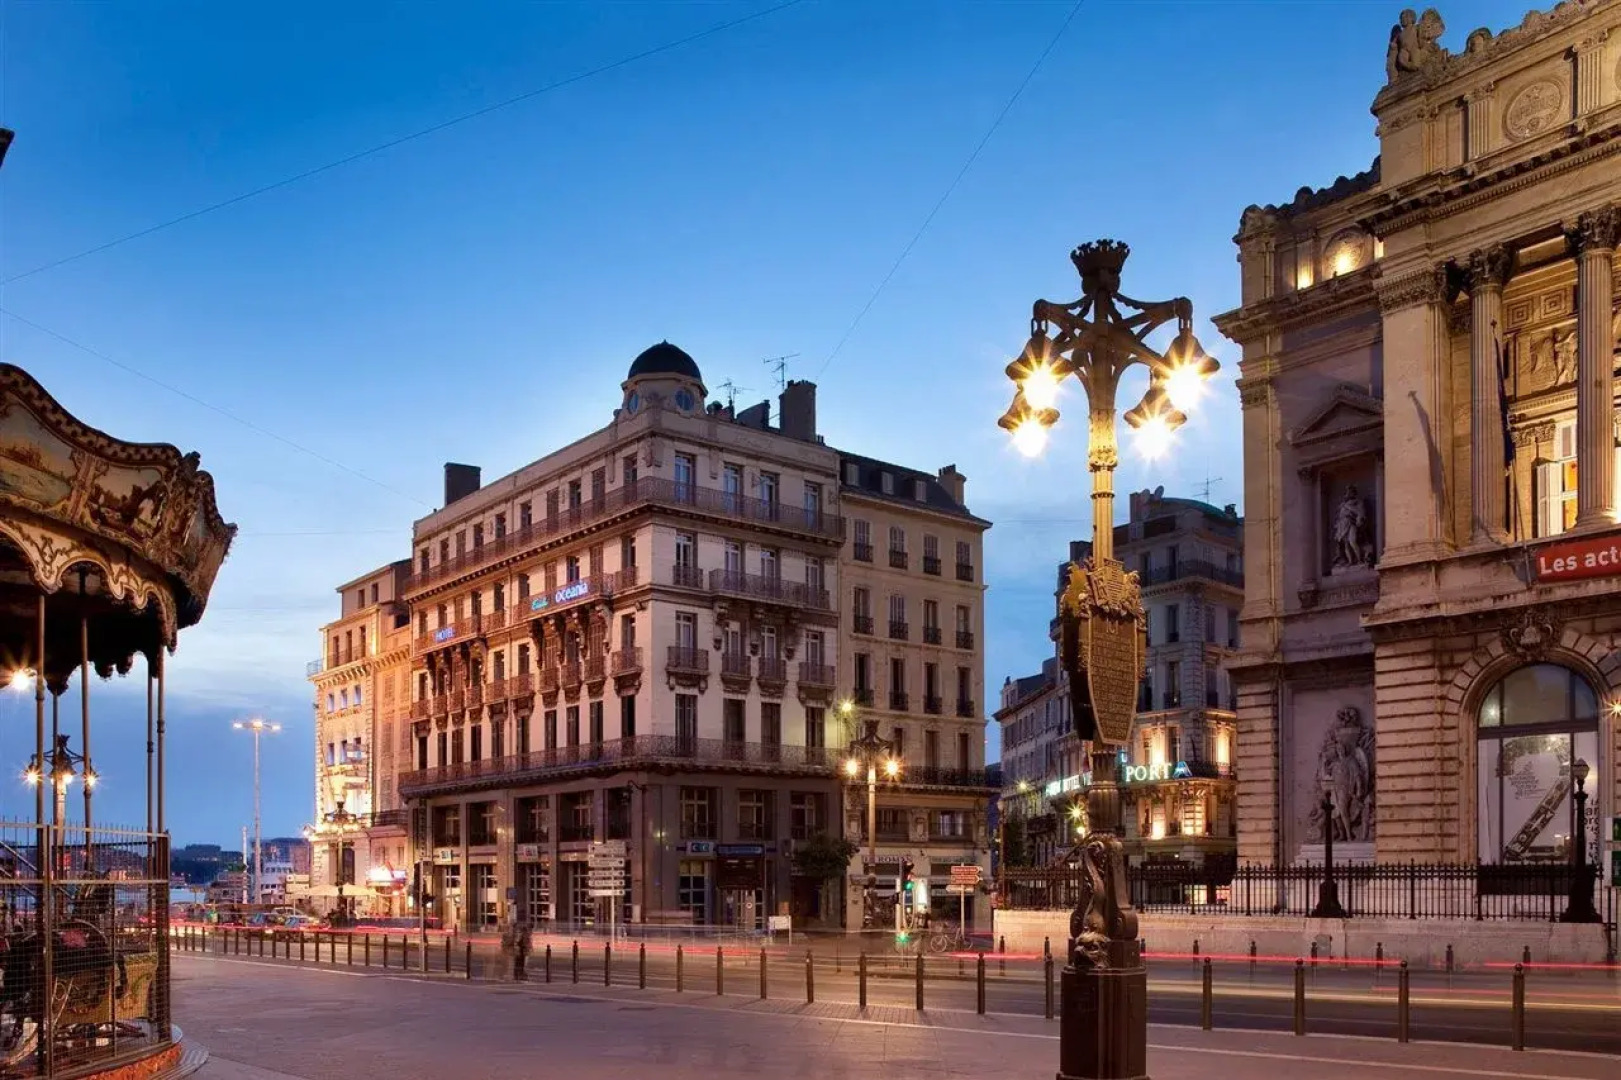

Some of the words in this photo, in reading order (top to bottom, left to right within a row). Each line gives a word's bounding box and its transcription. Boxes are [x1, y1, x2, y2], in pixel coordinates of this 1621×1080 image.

[1539, 556, 1578, 575] Les
[1584, 546, 1621, 568] act
[1126, 762, 1172, 782] PORT
